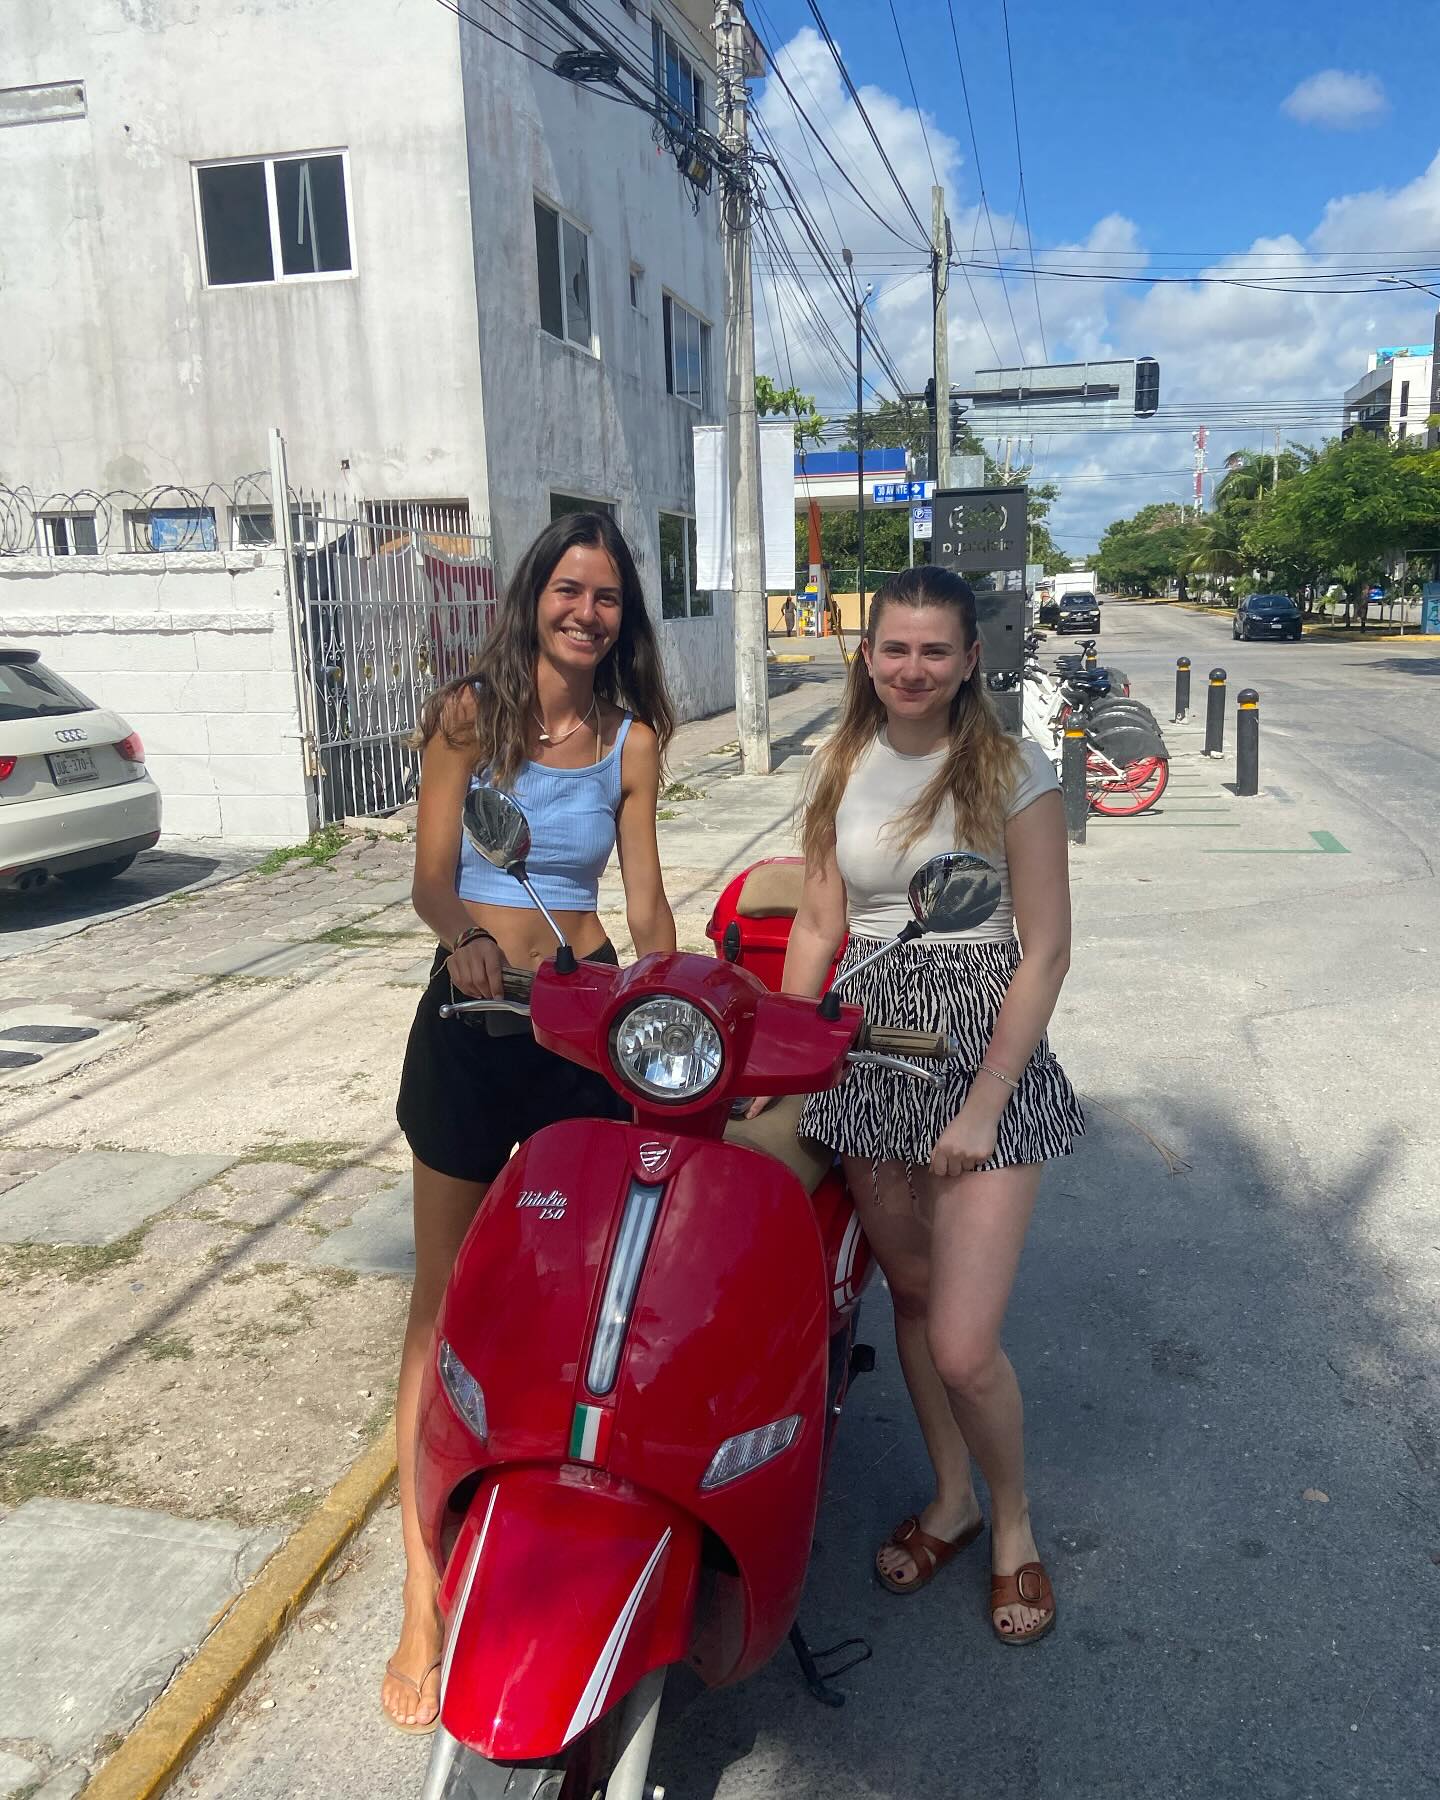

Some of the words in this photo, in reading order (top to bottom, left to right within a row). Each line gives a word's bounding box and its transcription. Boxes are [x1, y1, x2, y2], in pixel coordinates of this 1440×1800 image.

[877, 486, 885, 496] 30
[516, 1190, 568, 1208] Vitalia
[539, 1208, 565, 1220] 150
